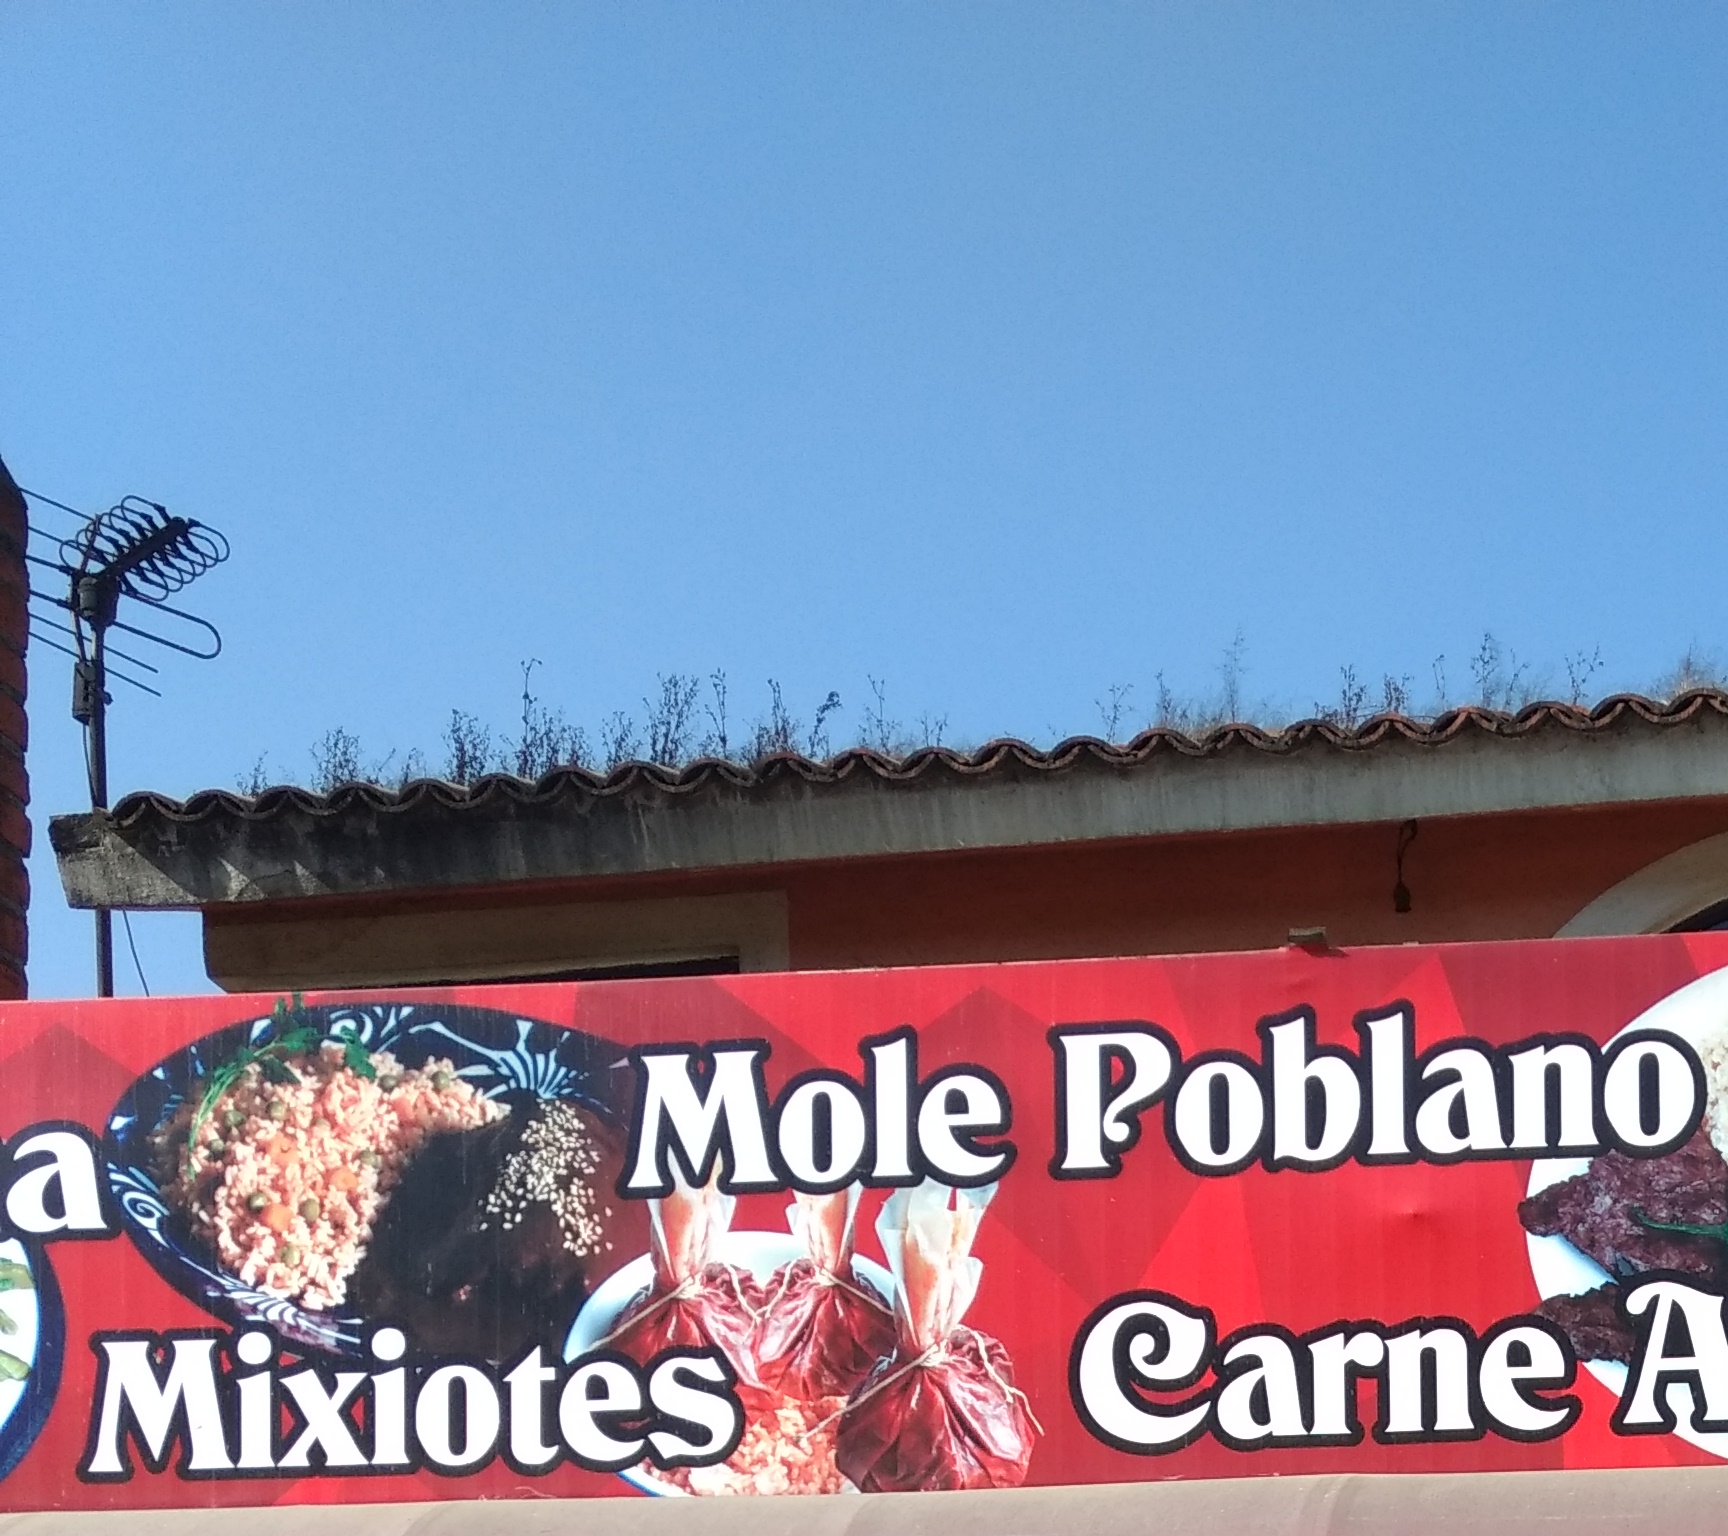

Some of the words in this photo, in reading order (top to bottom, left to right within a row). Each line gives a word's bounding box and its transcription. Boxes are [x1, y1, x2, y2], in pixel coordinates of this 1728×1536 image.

[624, 1028, 1014, 1192] Mole
[1050, 1003, 1704, 1176] Poblano
[80, 1328, 744, 1482] Mixiotes
[1072, 1290, 1582, 1454] Carne
